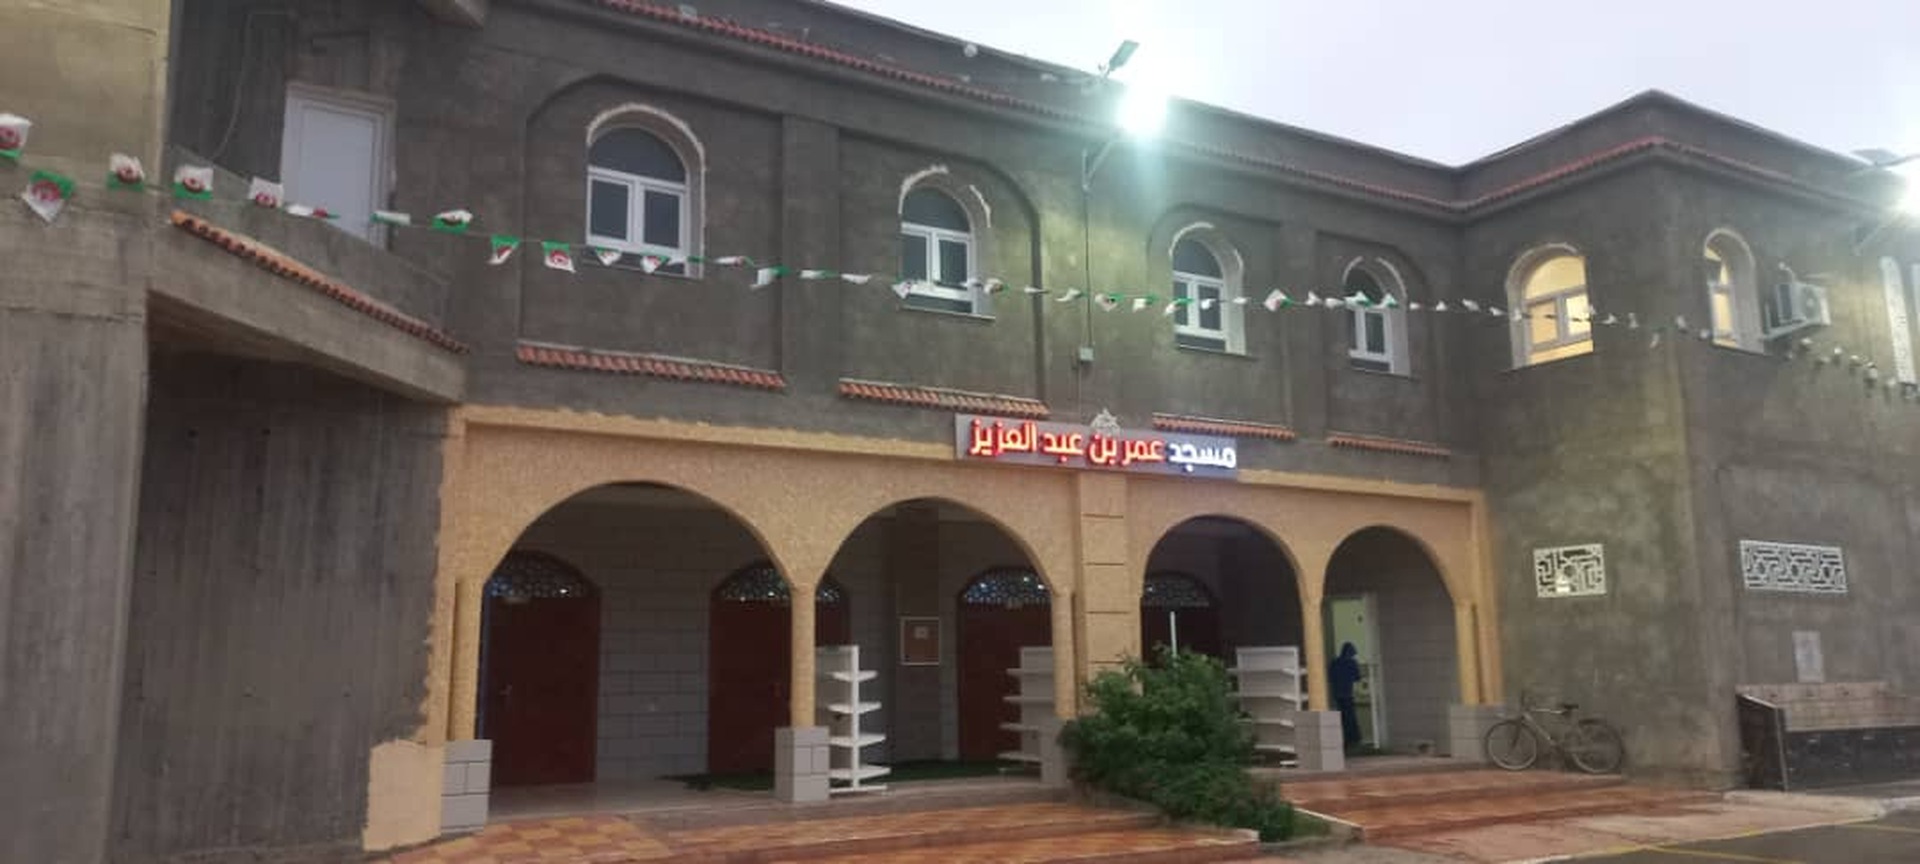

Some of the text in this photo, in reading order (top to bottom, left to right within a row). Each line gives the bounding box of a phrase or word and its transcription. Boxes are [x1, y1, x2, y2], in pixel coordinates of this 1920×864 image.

[970, 418, 1237, 472] مسجد عمر بن عبد العزيز
